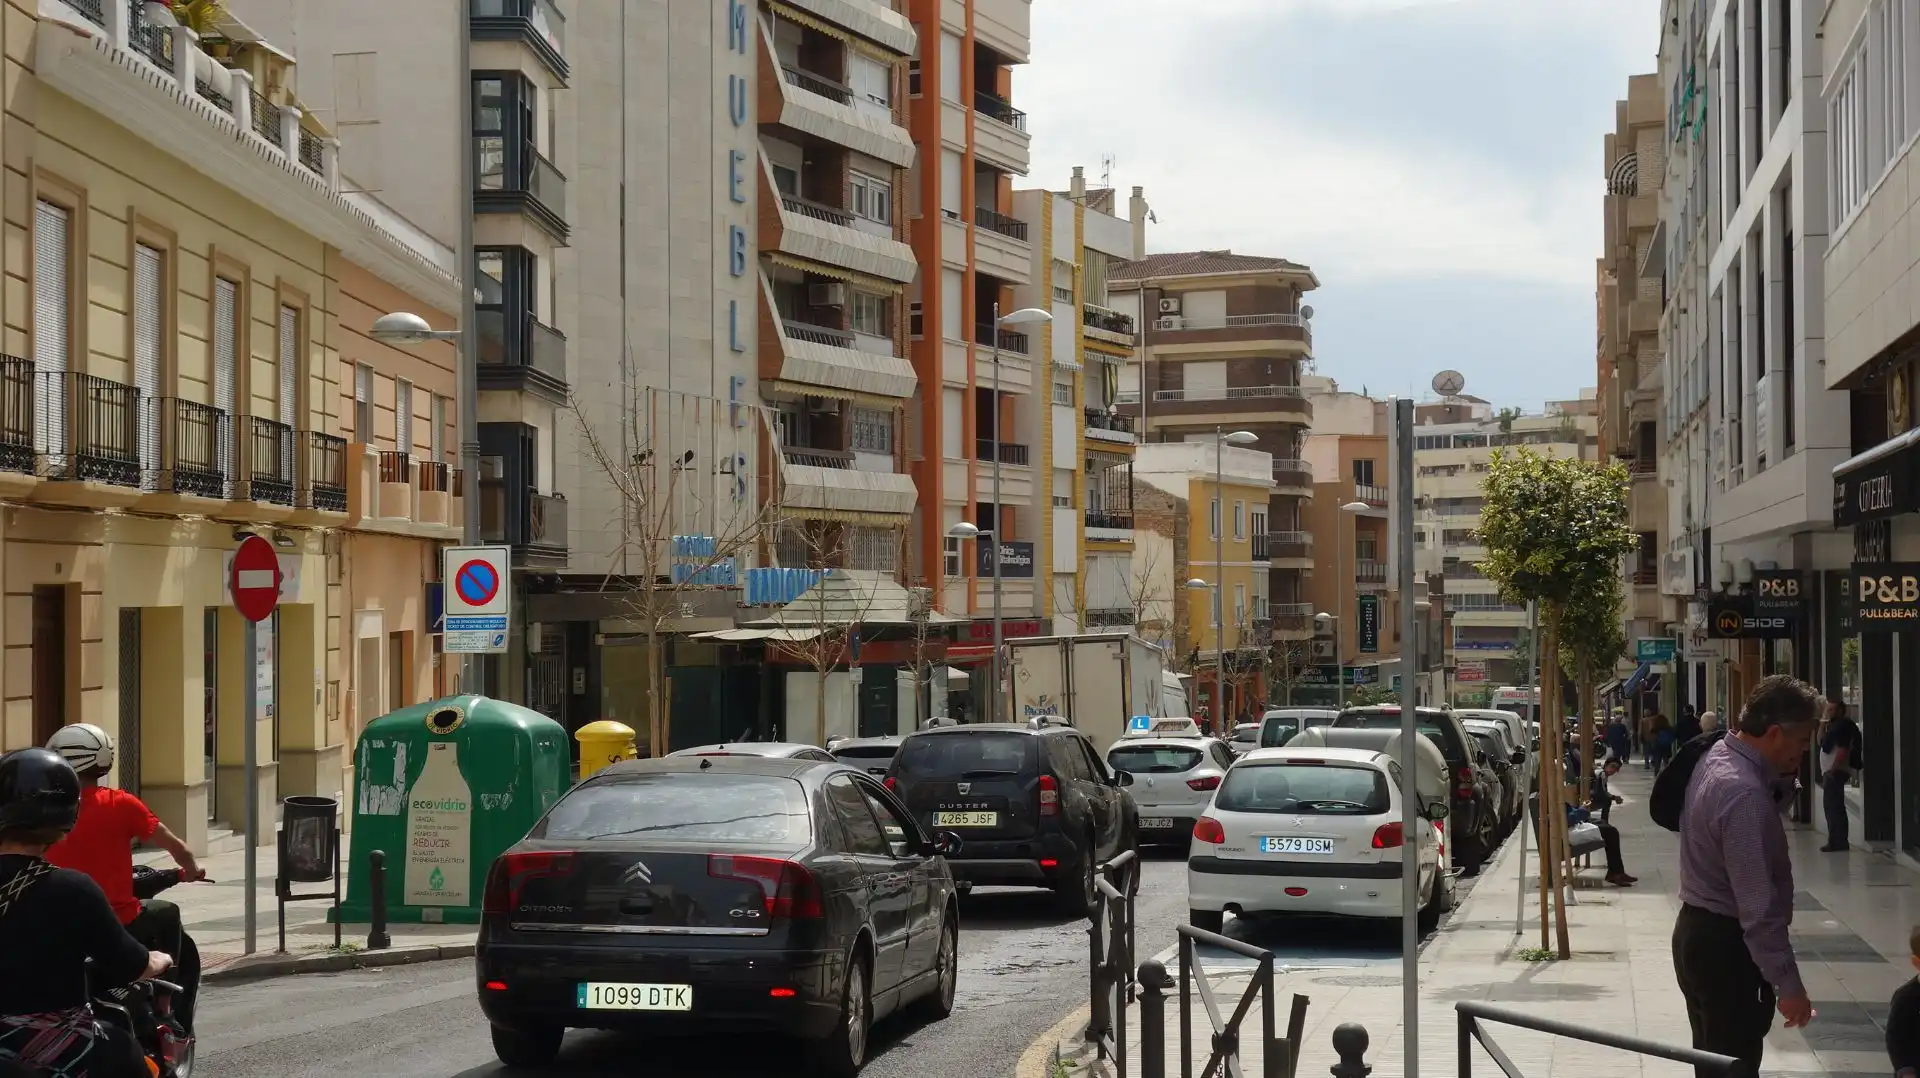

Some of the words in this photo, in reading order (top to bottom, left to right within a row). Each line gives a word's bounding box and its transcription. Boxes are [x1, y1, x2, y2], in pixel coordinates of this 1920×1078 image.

[729, 0, 746, 502] MUEBLES
[1759, 579, 1799, 596] P&B
[1859, 575, 1920, 602] P&B
[1859, 607, 1918, 618] PULL&BEAR
[1137, 718, 1145, 728] L
[412, 798, 467, 811] ecovidrio
[941, 813, 969, 824] 4265
[972, 813, 993, 824] JSF
[412, 838, 451, 848] REDUCIR
[1268, 838, 1302, 851] 5579
[1306, 838, 1331, 851] DSM
[729, 909, 760, 918] C5
[594, 986, 642, 1005] 1099
[649, 987, 687, 1006] DTK
